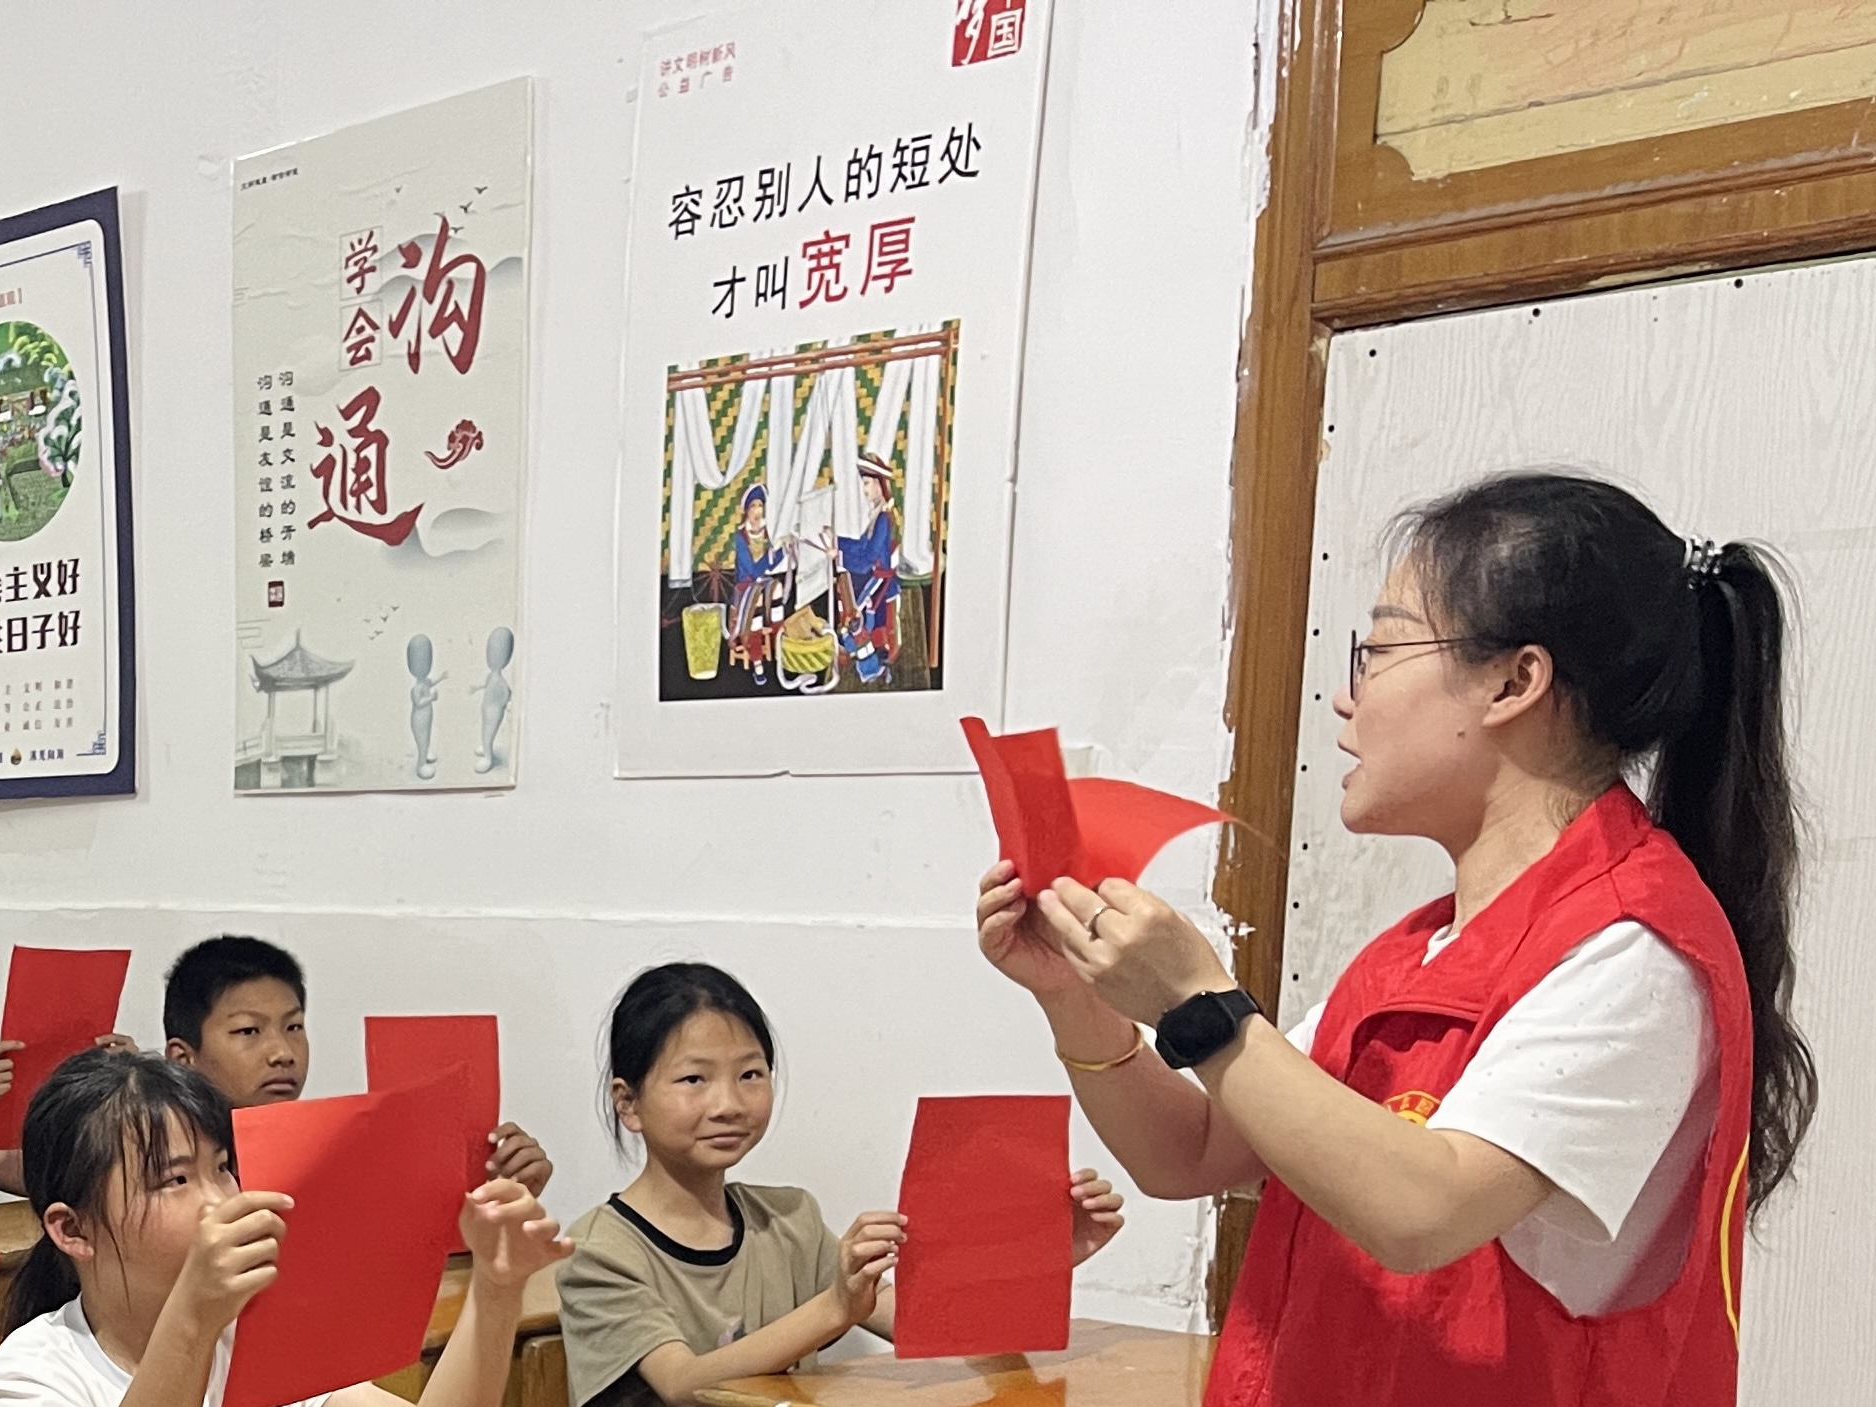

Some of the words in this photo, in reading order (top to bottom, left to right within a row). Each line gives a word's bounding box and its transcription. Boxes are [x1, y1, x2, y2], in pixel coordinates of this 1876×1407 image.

[668, 122, 981, 240] 容忍别人的短处
[712, 216, 915, 318] 才叫宽厚
